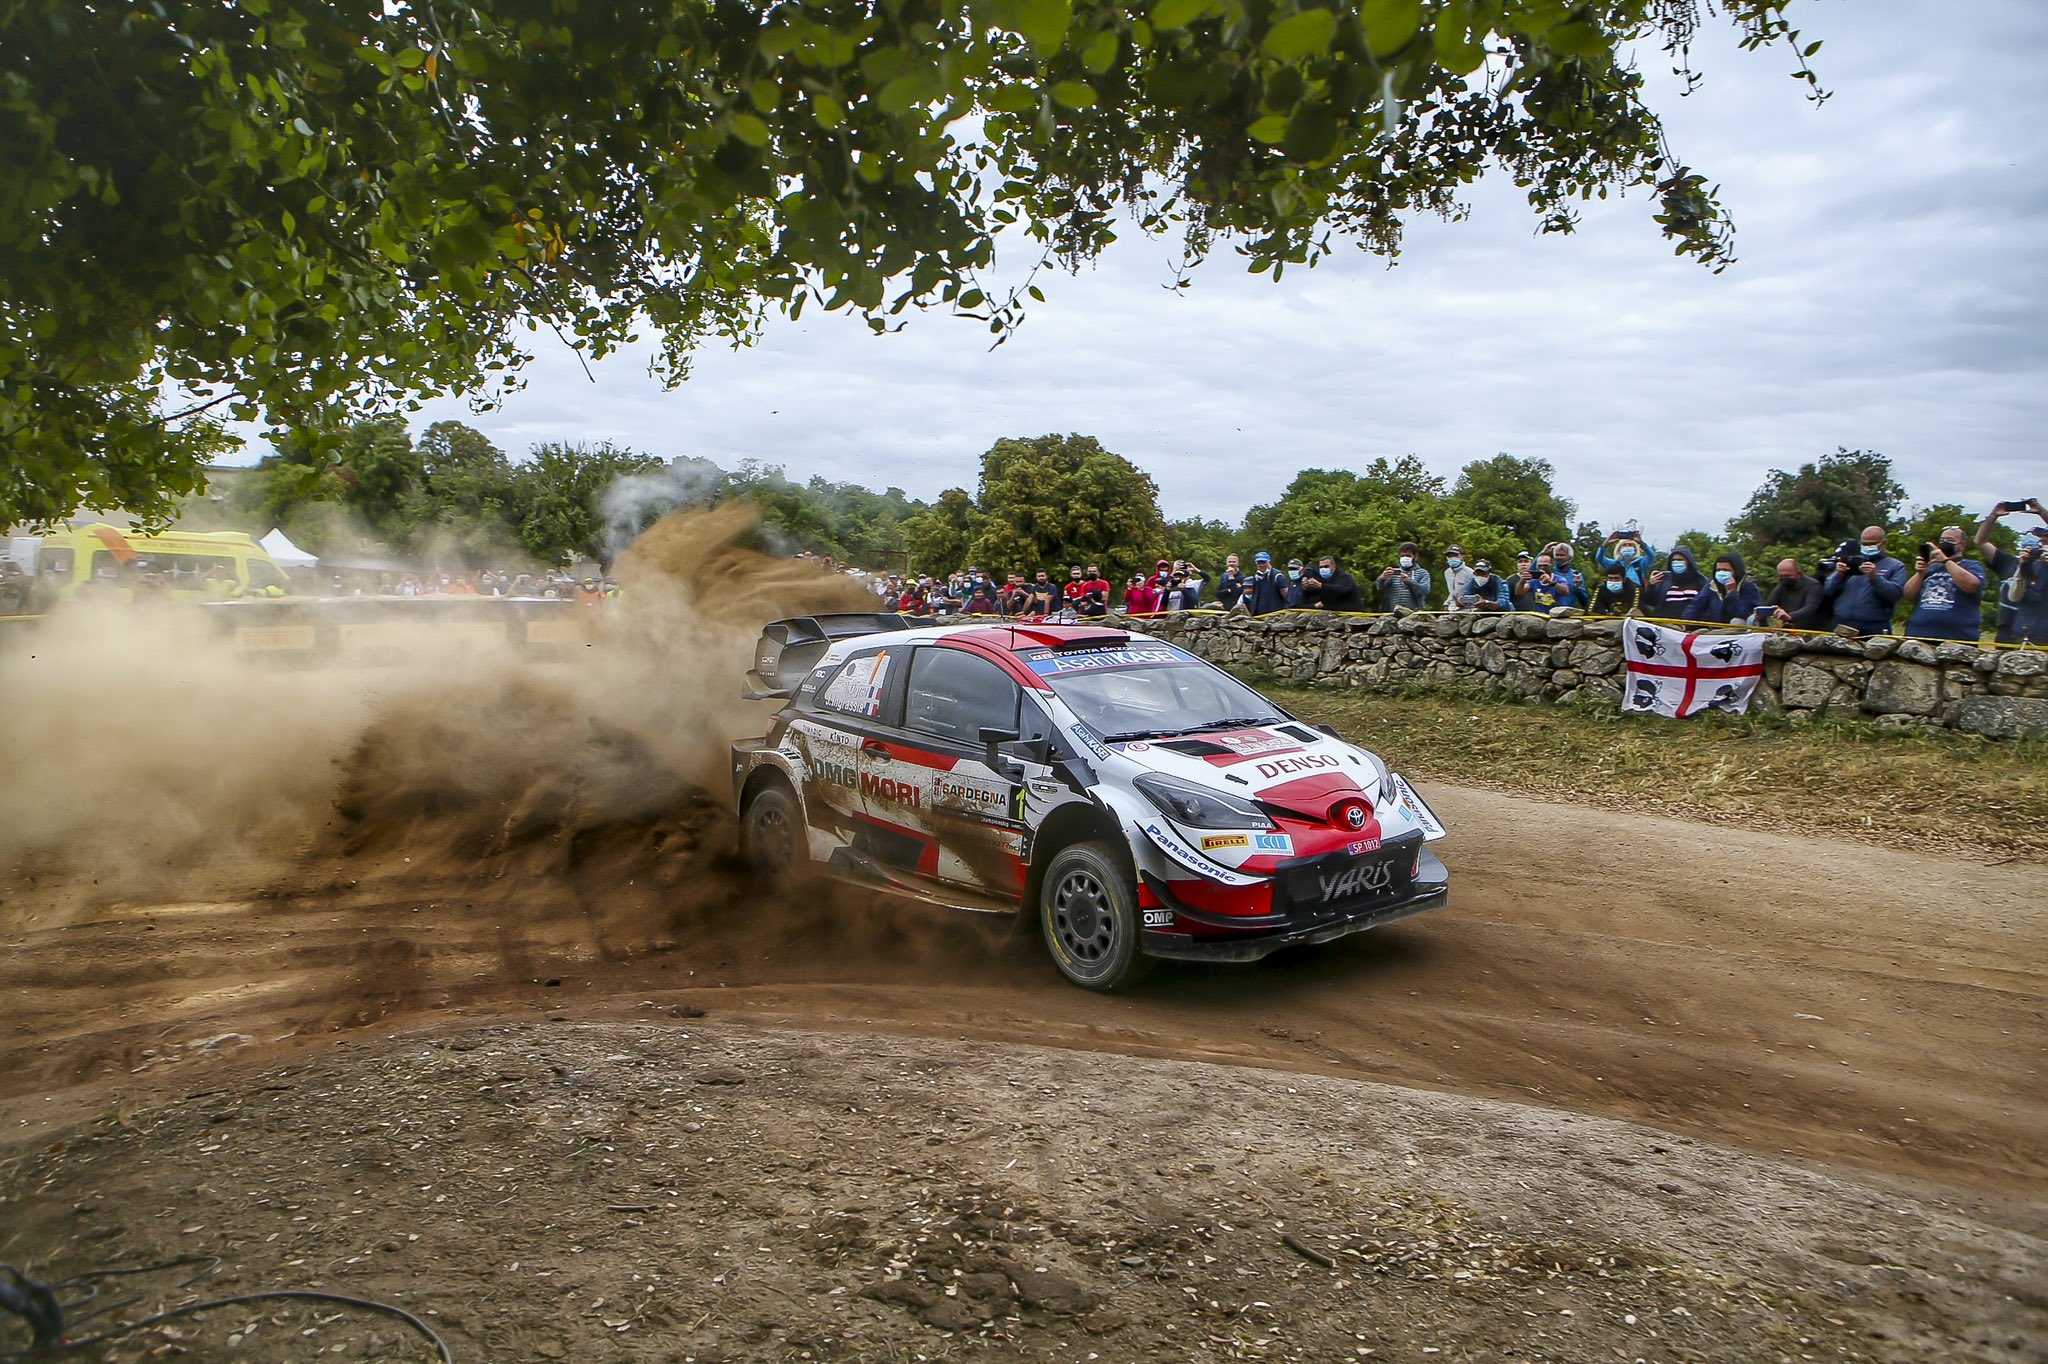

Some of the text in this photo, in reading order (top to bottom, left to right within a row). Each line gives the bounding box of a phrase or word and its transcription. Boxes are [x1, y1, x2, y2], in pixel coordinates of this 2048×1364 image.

[1053, 650, 1181, 671] AsahiKASEI
[1055, 648, 1099, 657] TOYOTA
[868, 649, 887, 685] 1
[1255, 754, 1340, 779] DENSO
[860, 771, 922, 808] MORI
[942, 783, 1007, 806] SARDEGNA
[1015, 788, 1026, 820] 1
[1204, 835, 1246, 848] PIRELLI
[1353, 839, 1379, 853] SP 1012
[1146, 824, 1237, 883] Panasonic
[1143, 911, 1174, 924] OMP
